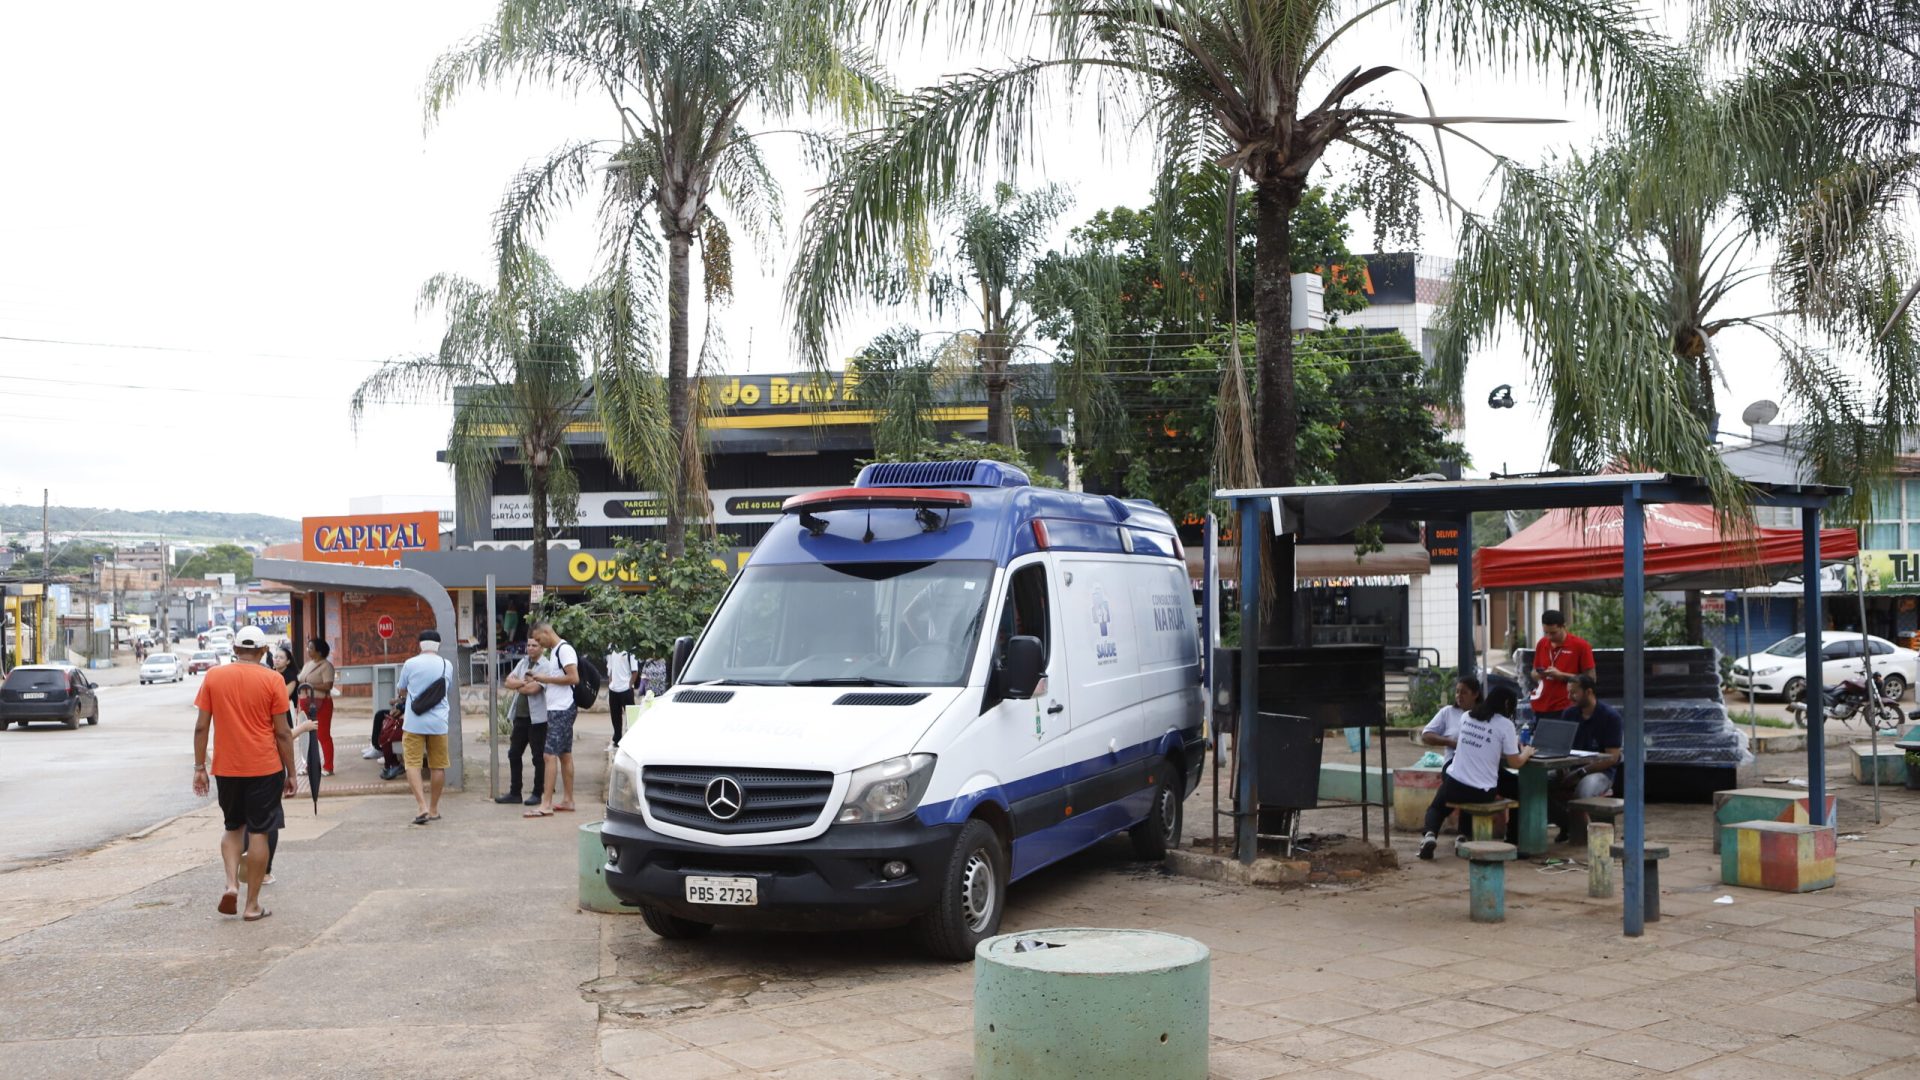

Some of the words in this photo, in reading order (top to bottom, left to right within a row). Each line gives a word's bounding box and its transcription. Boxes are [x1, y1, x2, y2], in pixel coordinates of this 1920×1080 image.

[720, 378, 760, 406] do
[736, 501, 749, 510] ATÉ
[750, 501, 760, 509] 40
[761, 501, 781, 509] DIAS
[314, 522, 427, 553] CAPITAL
[1436, 530, 1458, 539] DELIVER
[1153, 607, 1169, 632] NA
[1167, 607, 1186, 631] RUA
[379, 623, 393, 631] PARE
[1461, 738, 1482, 748] Cuidar
